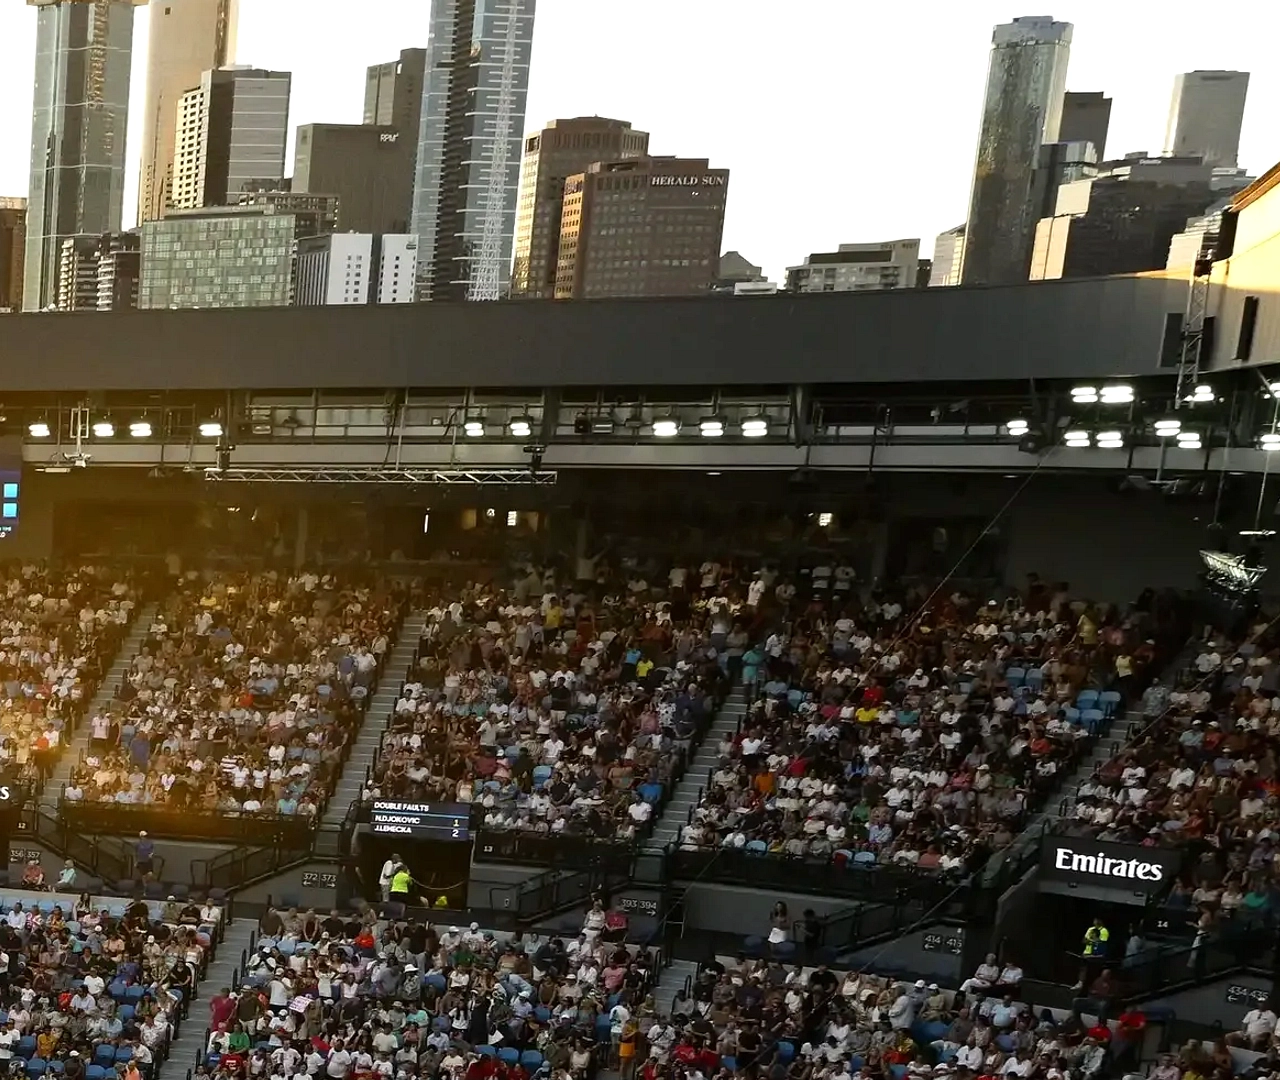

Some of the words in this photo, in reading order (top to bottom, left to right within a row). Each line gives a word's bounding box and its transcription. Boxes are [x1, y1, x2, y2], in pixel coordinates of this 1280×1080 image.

[651, 176, 698, 186] HERALD
[701, 176, 725, 185] SUN
[374, 801, 402, 811] DOUBLE
[402, 804, 430, 813] FAULTS
[10, 849, 24, 858] 356
[27, 850, 41, 859] 357
[1054, 847, 1163, 882] Emirates
[303, 872, 318, 880] 372
[321, 874, 337, 882] 373
[622, 898, 638, 908] 393
[640, 899, 657, 909] 394
[1156, 920, 1169, 928] 14
[924, 935, 940, 944] 414
[946, 937, 962, 947] 415
[1227, 985, 1248, 996] 434
